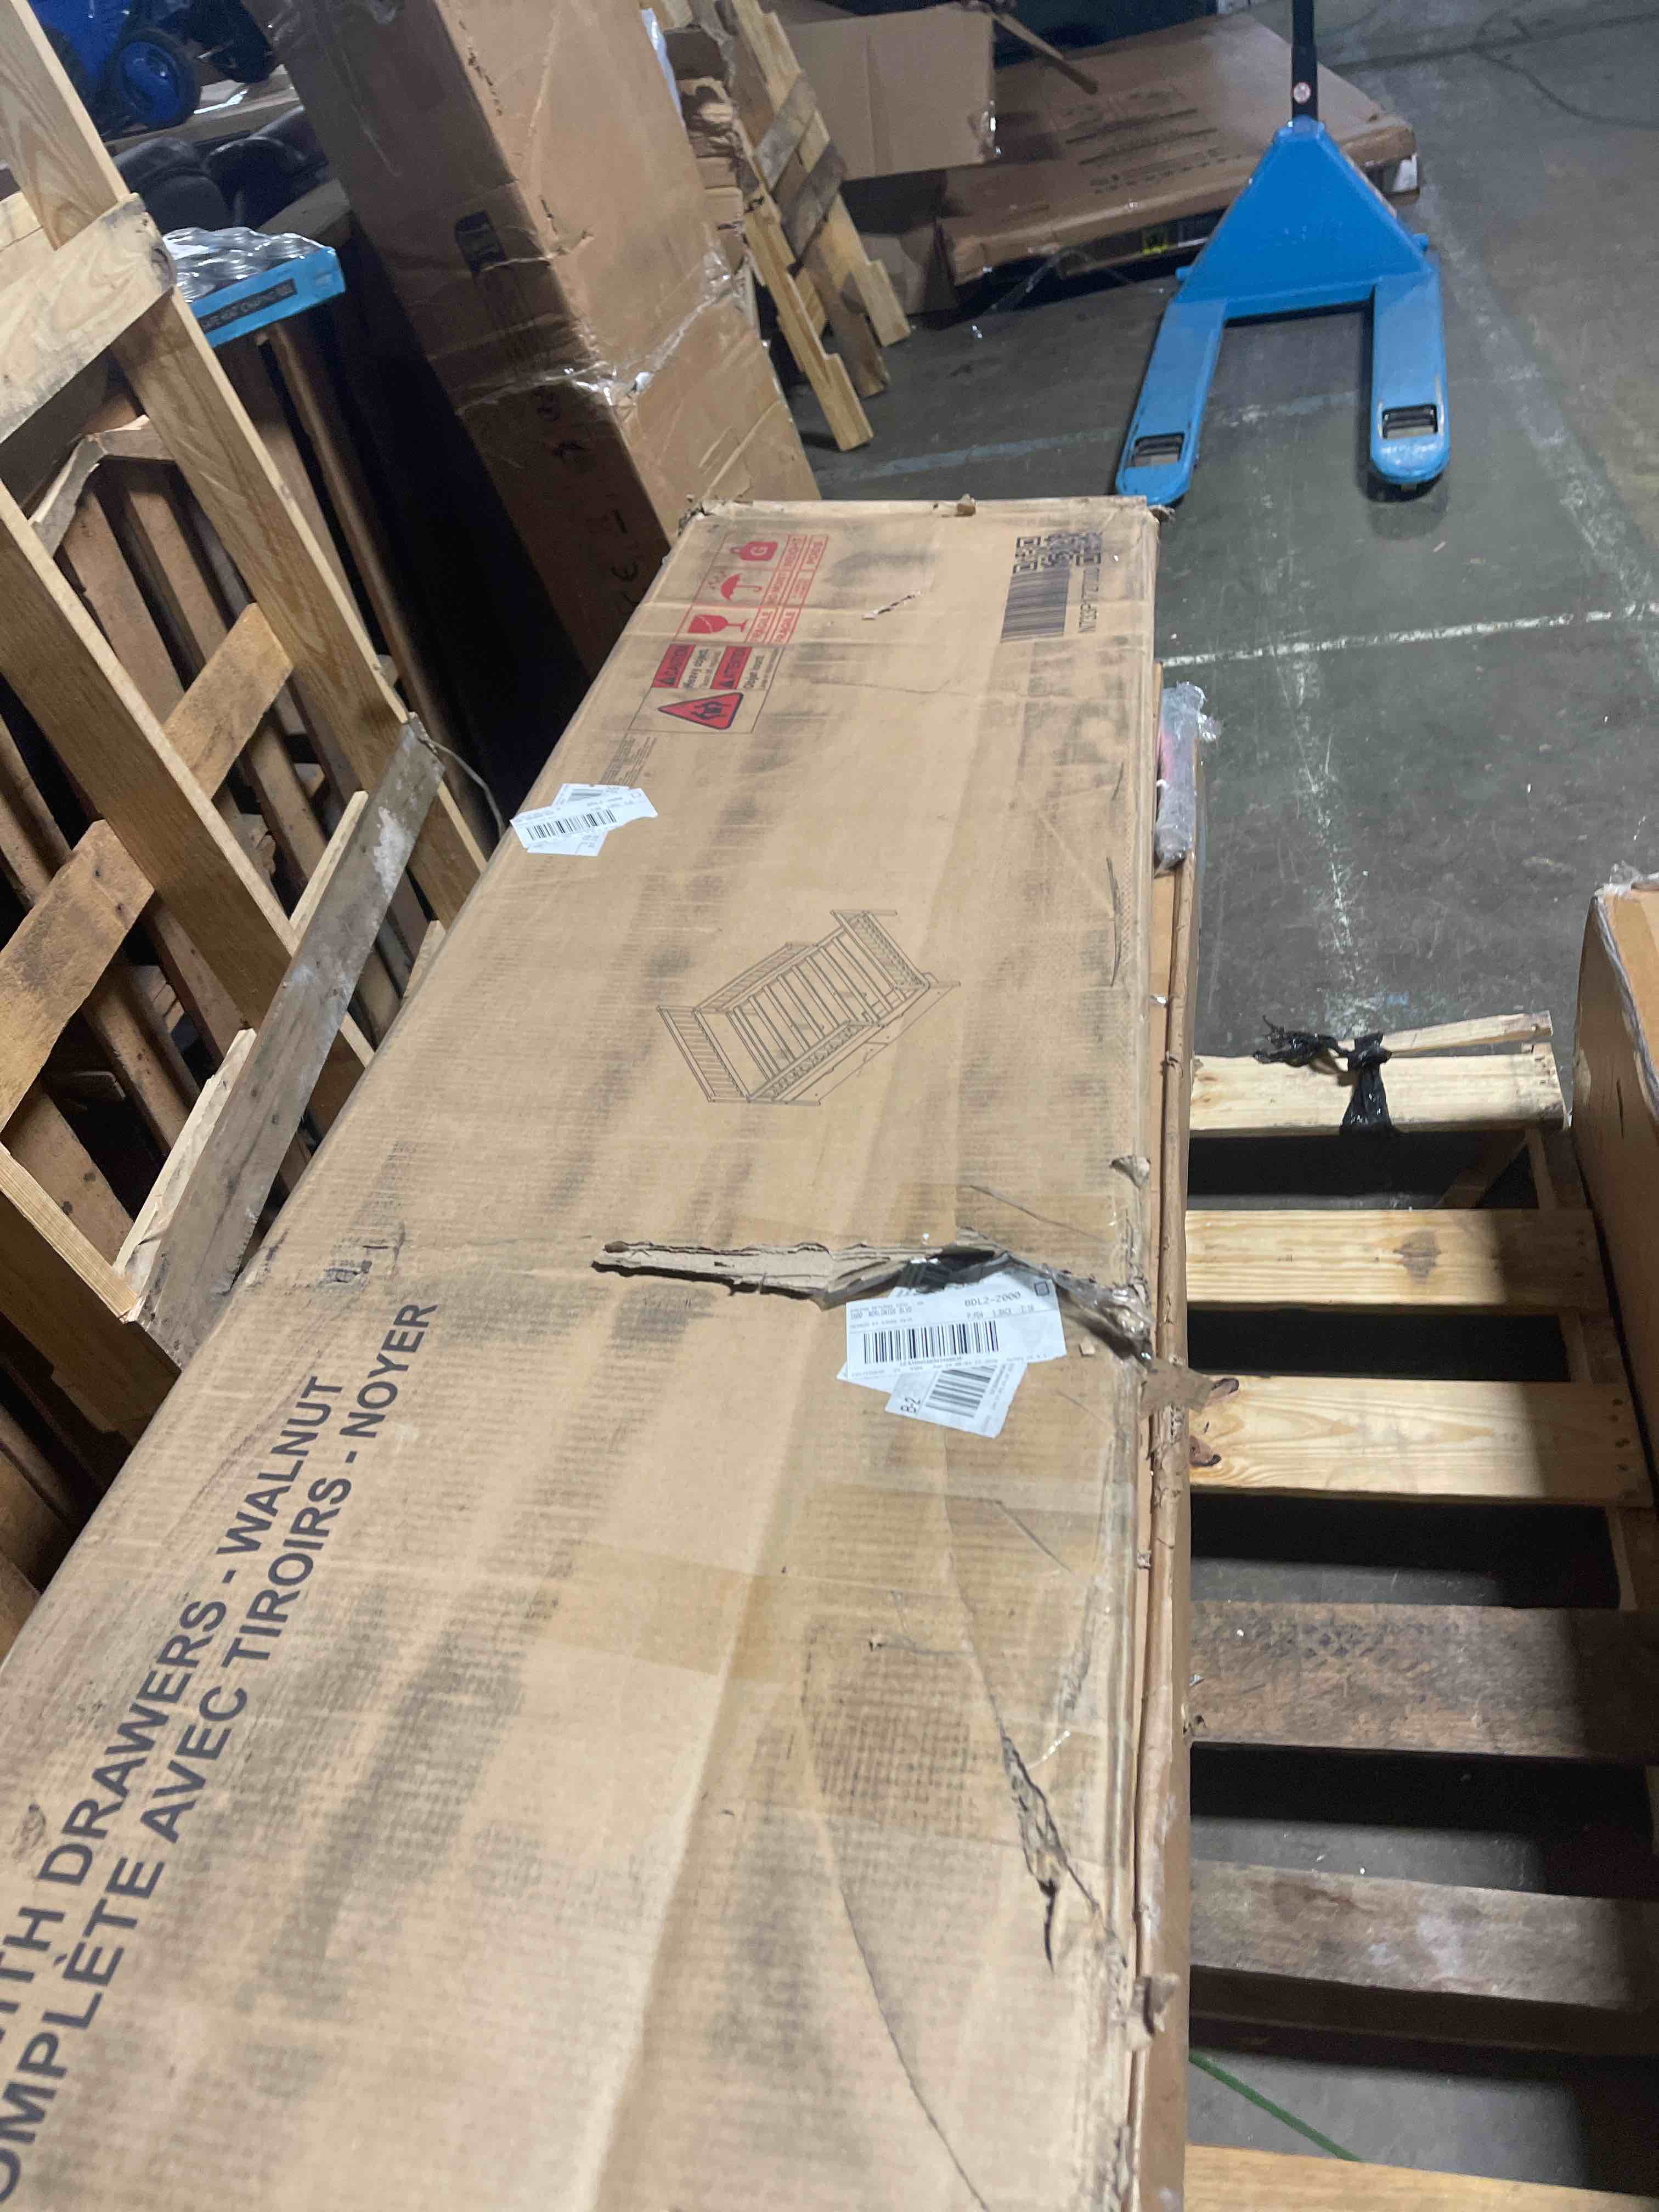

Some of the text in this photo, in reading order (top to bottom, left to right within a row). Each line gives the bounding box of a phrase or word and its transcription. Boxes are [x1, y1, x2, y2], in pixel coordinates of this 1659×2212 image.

[0, 1905, 66, 2045] TH
[38, 1599, 227, 1886] DRAWERS
[217, 1375, 343, 1556] WALNUT
[140, 1685, 248, 1844] AVEC
[222, 1477, 352, 1661] TIROIRS
[339, 1302, 438, 1438] NOYER
